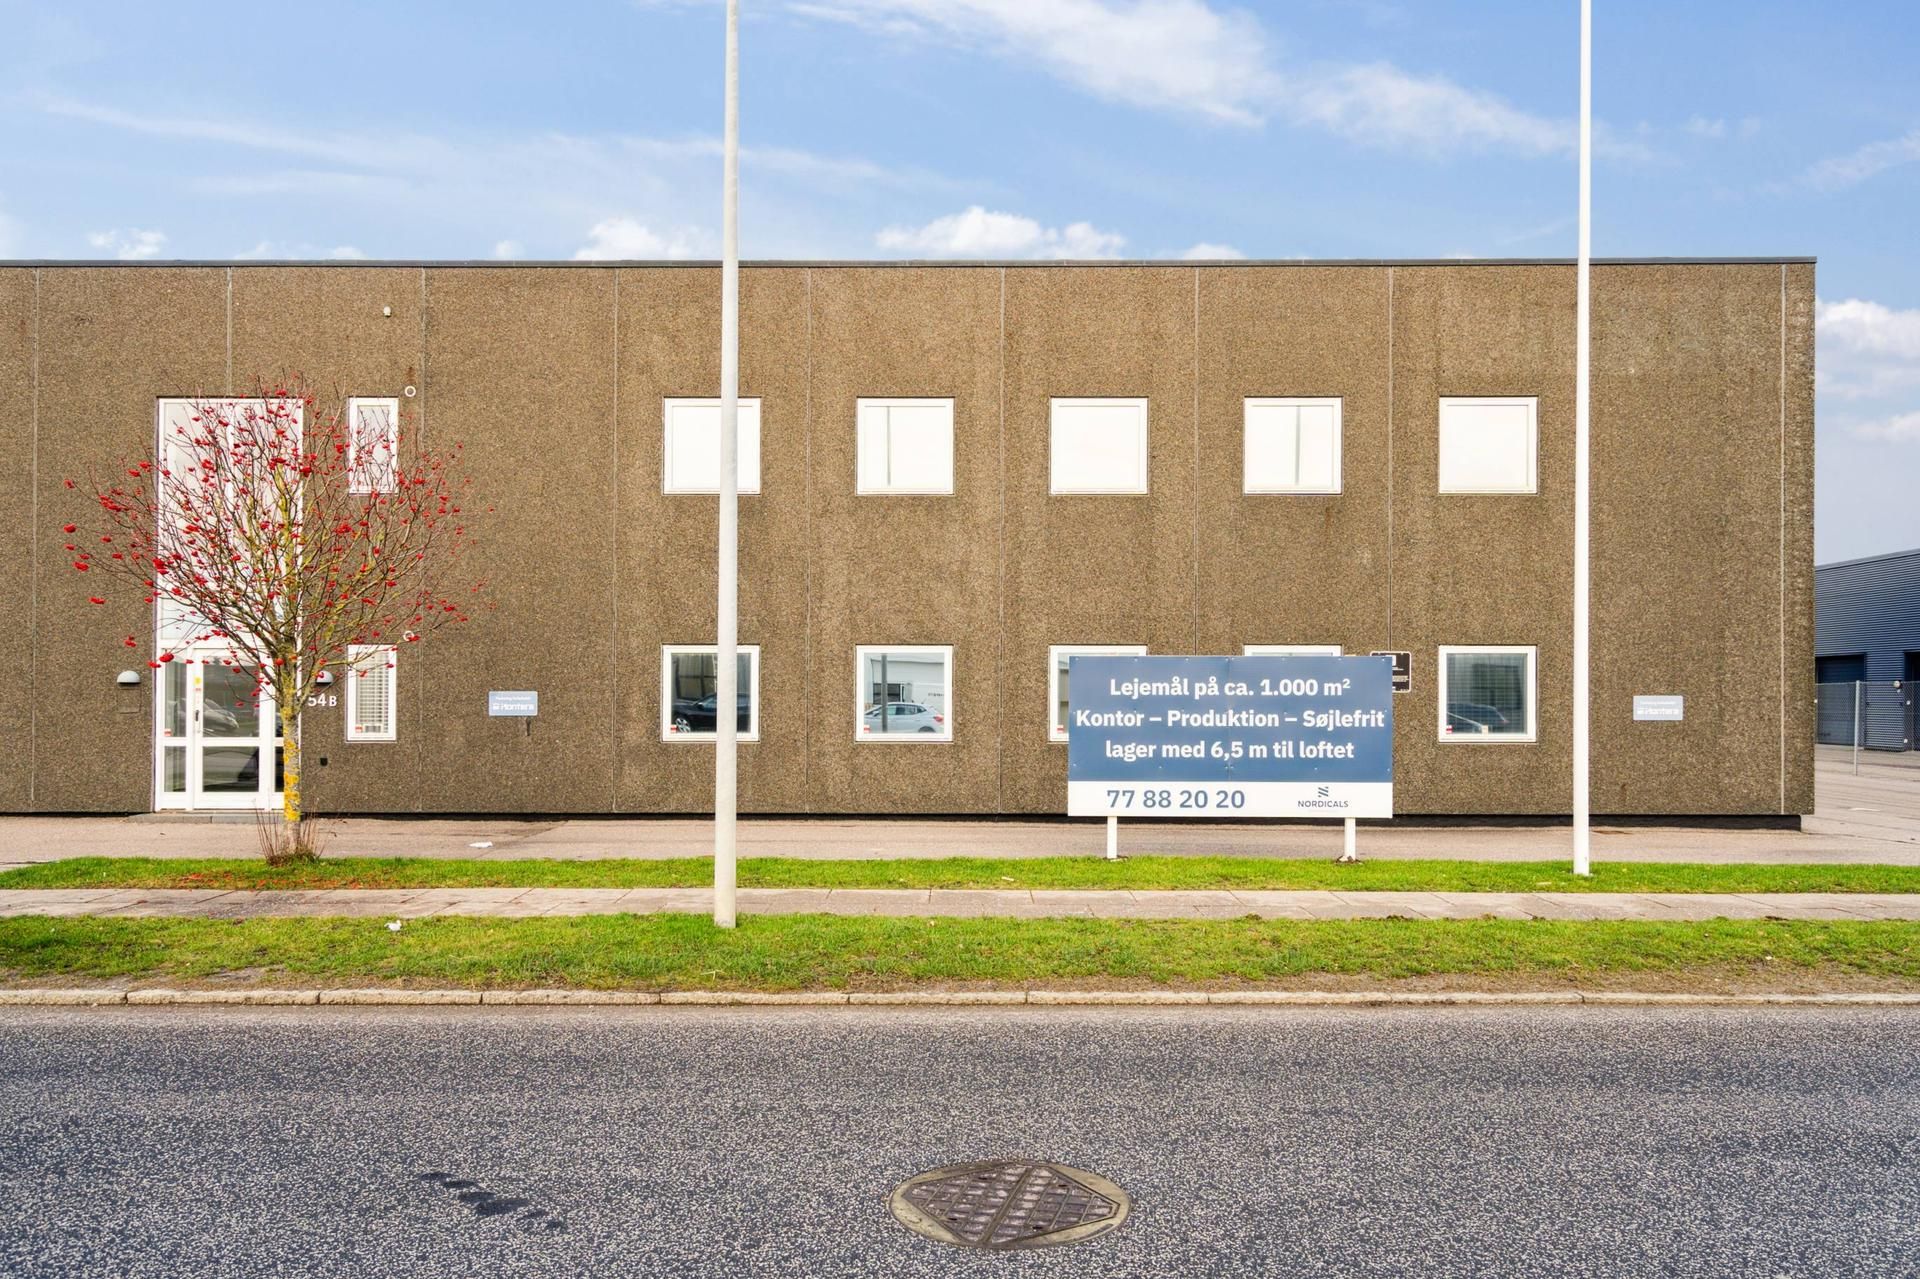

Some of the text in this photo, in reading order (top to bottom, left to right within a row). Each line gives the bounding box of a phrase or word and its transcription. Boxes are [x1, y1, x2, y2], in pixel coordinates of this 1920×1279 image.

[1109, 676, 1190, 701] Lejemål
[1194, 676, 1220, 700] på
[1223, 682, 1255, 697] ca.
[1259, 678, 1319, 697] 1.000
[307, 693, 338, 707] 54 B
[1076, 710, 1145, 728] Kontor
[1167, 709, 1280, 728] Produktion
[1302, 709, 1385, 732] Søjlefrit
[1105, 740, 1355, 762] lager med 6,5 m til loftet
[1107, 790, 1245, 809] 77 88 20 20
[1297, 800, 1350, 808] NORDICALS
